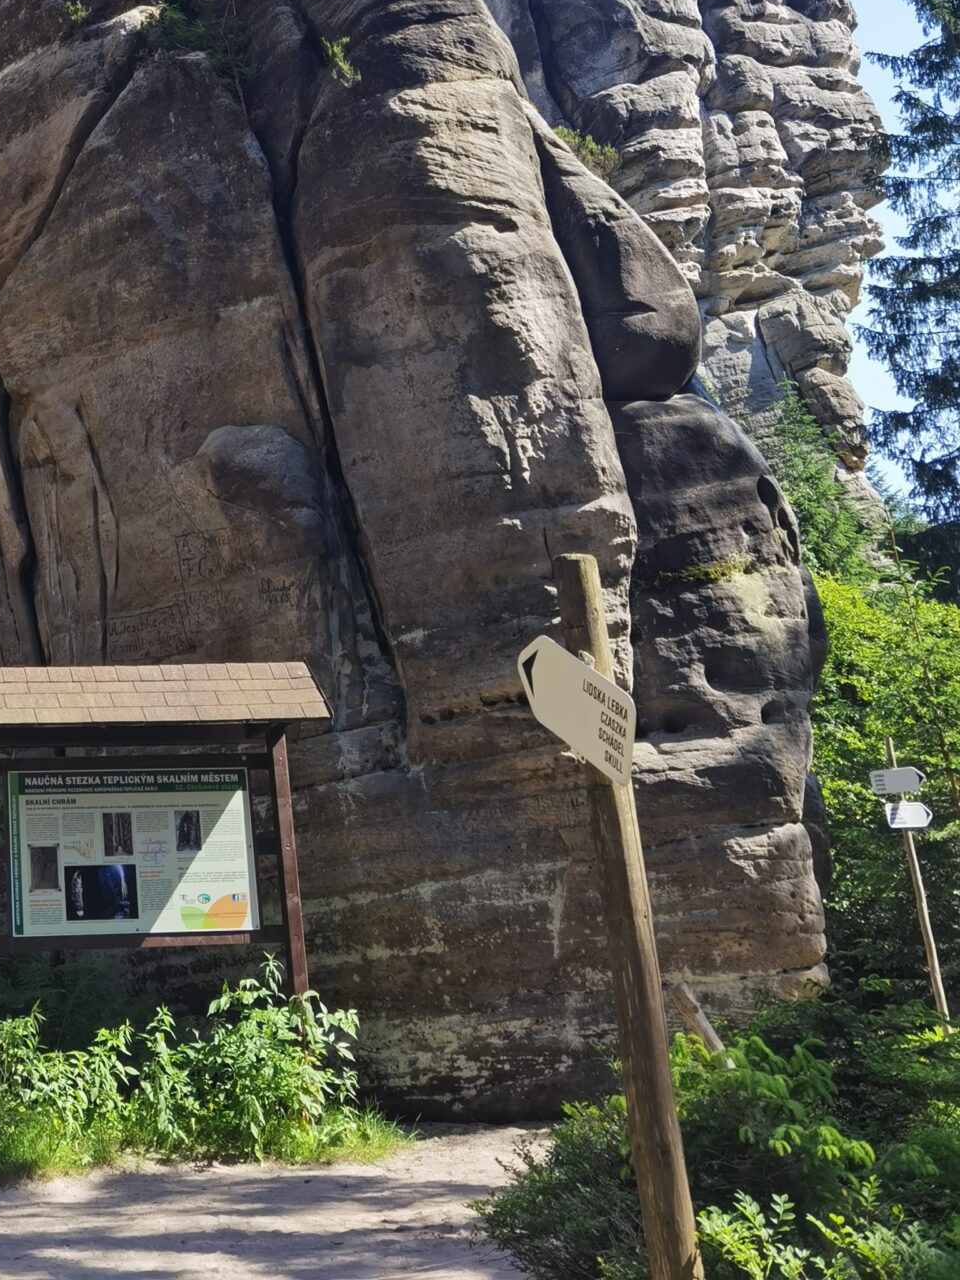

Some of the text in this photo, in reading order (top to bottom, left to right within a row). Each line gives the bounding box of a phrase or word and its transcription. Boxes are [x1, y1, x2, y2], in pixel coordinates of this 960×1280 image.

[607, 696, 628, 722] LEBKA
[600, 711, 627, 740] CZASZKA
[604, 750, 623, 774] SKULL
[25, 772, 239, 786] NAUČNÁ STEZKA TEPLICKÝM SKALNÍM MĚSTEM
[25, 797, 77, 806] SKALNÍ CHRÁM
